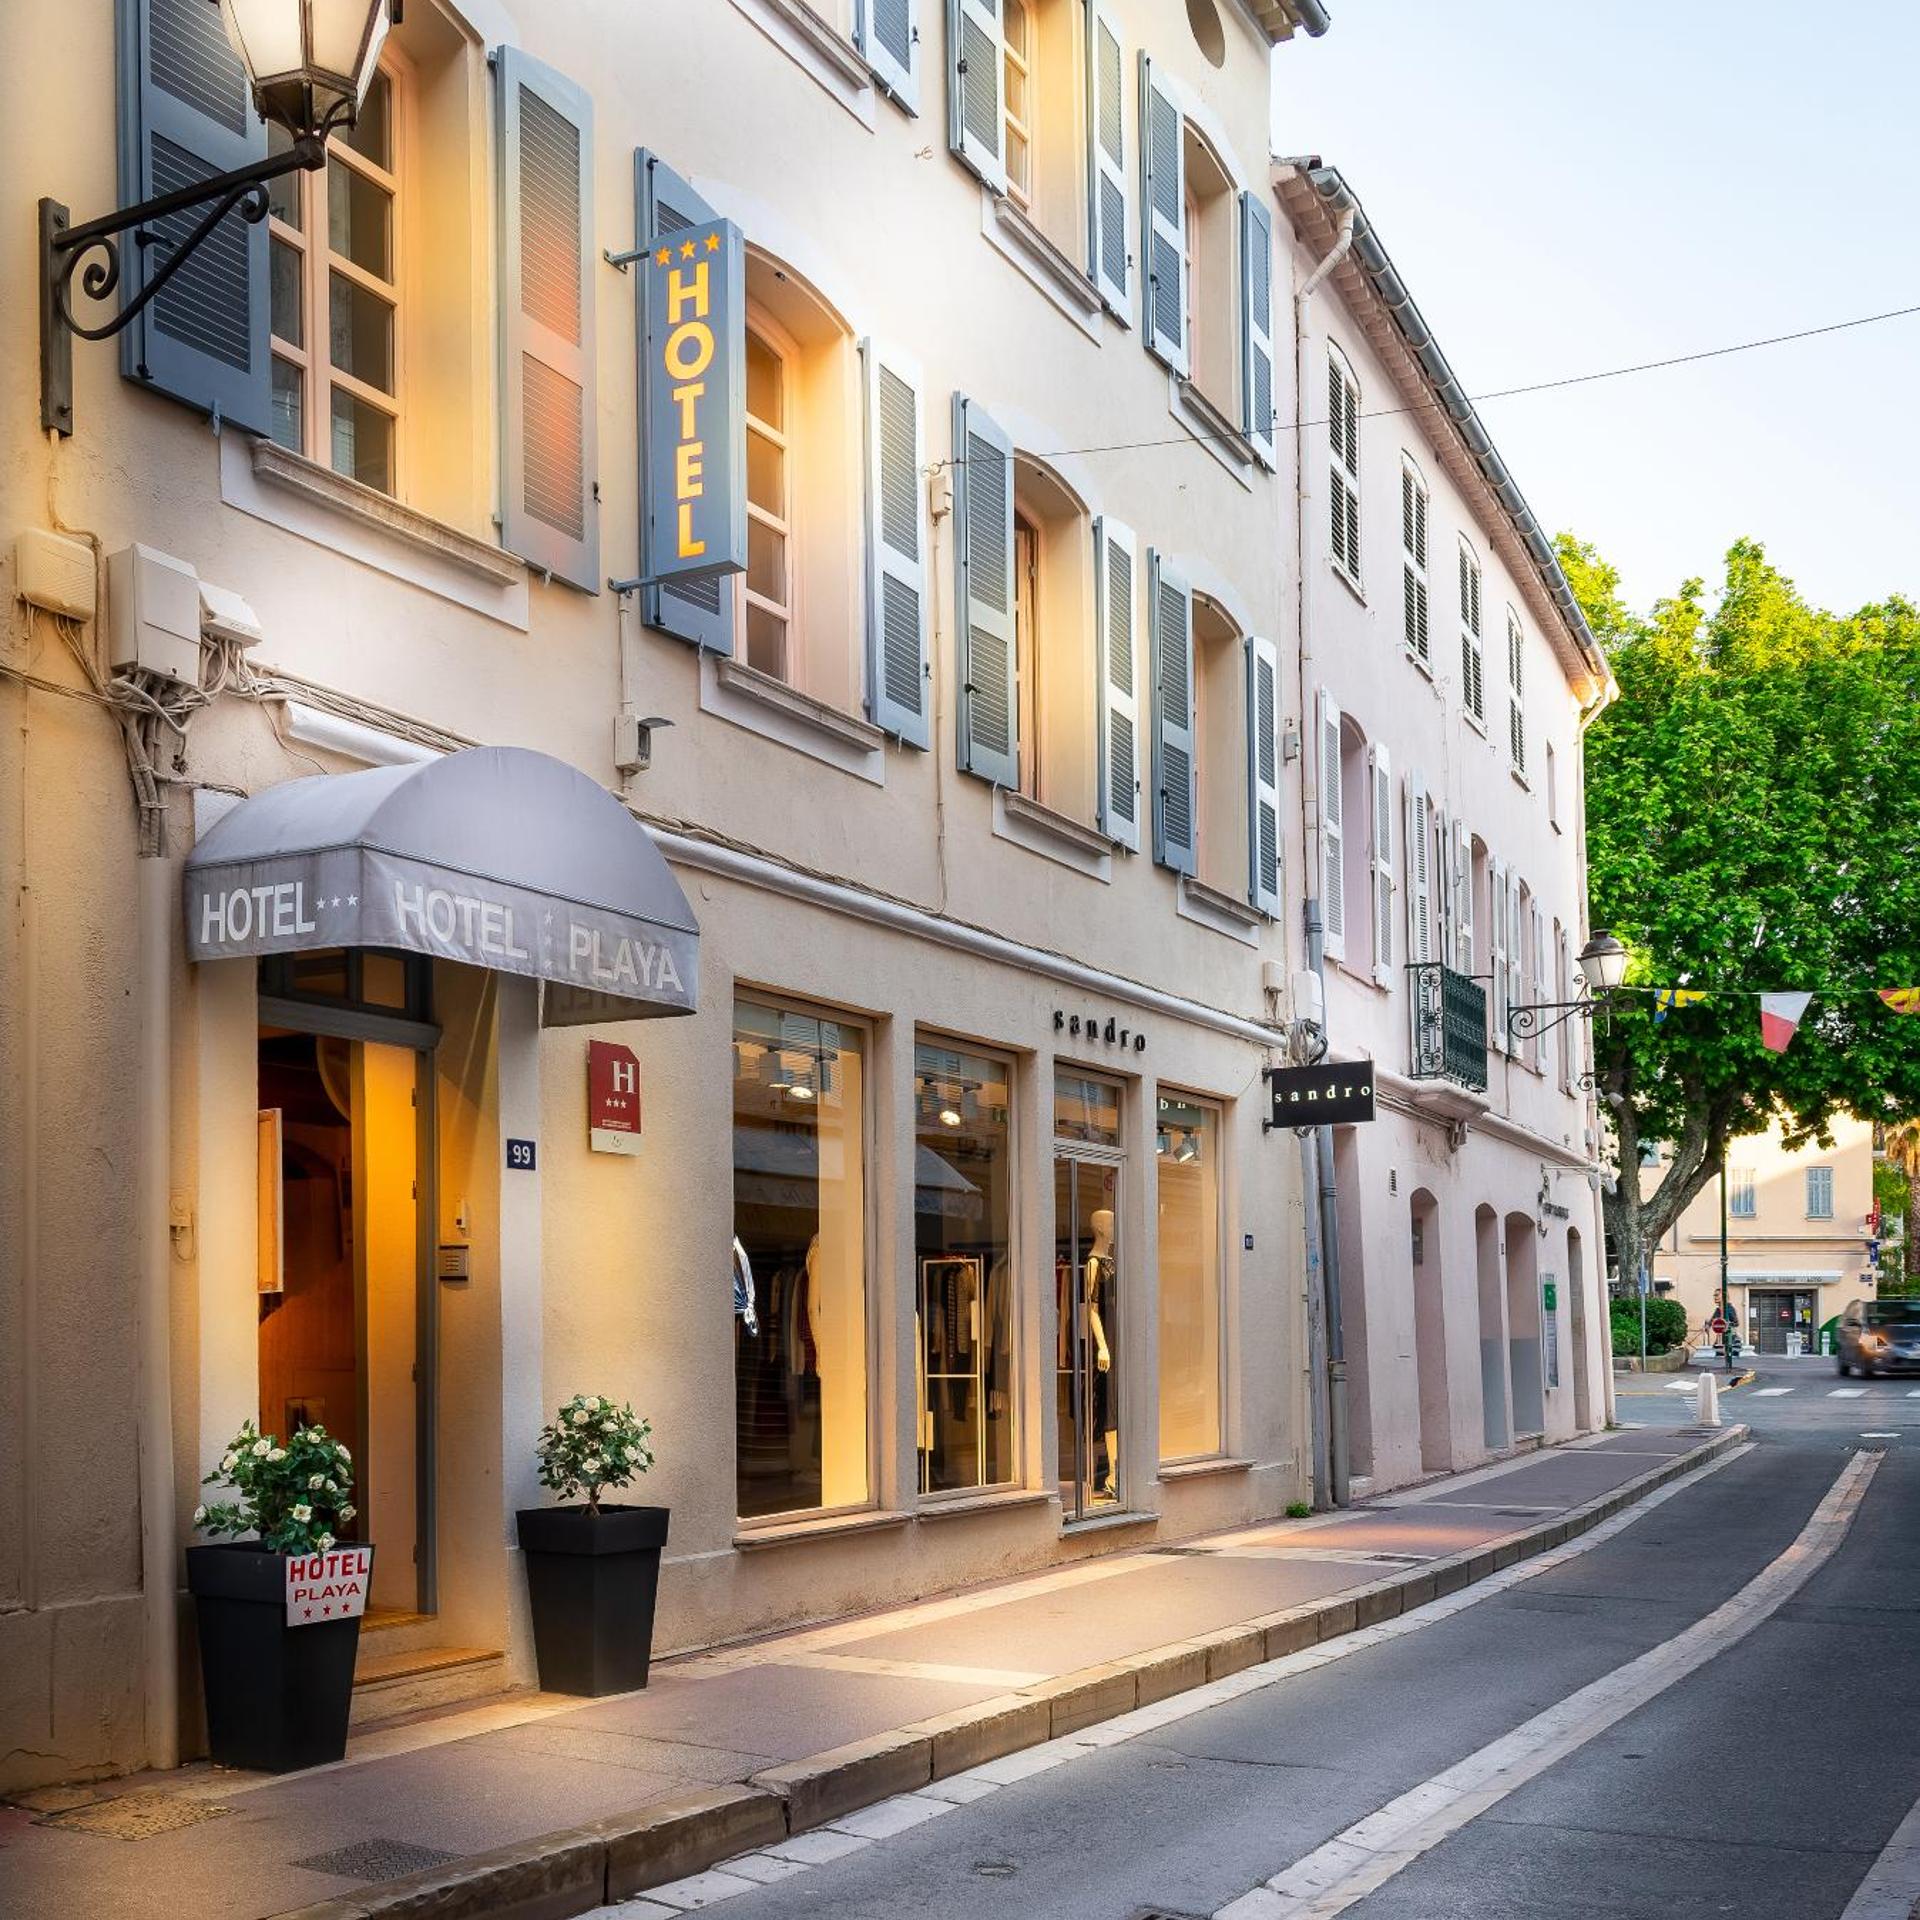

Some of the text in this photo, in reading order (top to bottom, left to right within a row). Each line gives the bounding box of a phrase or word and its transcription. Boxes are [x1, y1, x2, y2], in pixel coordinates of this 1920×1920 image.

[664, 261, 715, 559] HOTEL
[201, 881, 317, 944] HOTEL
[395, 880, 685, 993] HOTEL PLAYA
[1053, 1009, 1146, 1052] sandro
[612, 1060, 636, 1094] H
[1274, 1083, 1371, 1104] sandro
[513, 1144, 531, 1165] 99
[289, 1552, 368, 1583] HOTEL
[294, 1581, 360, 1603] PLAYA
